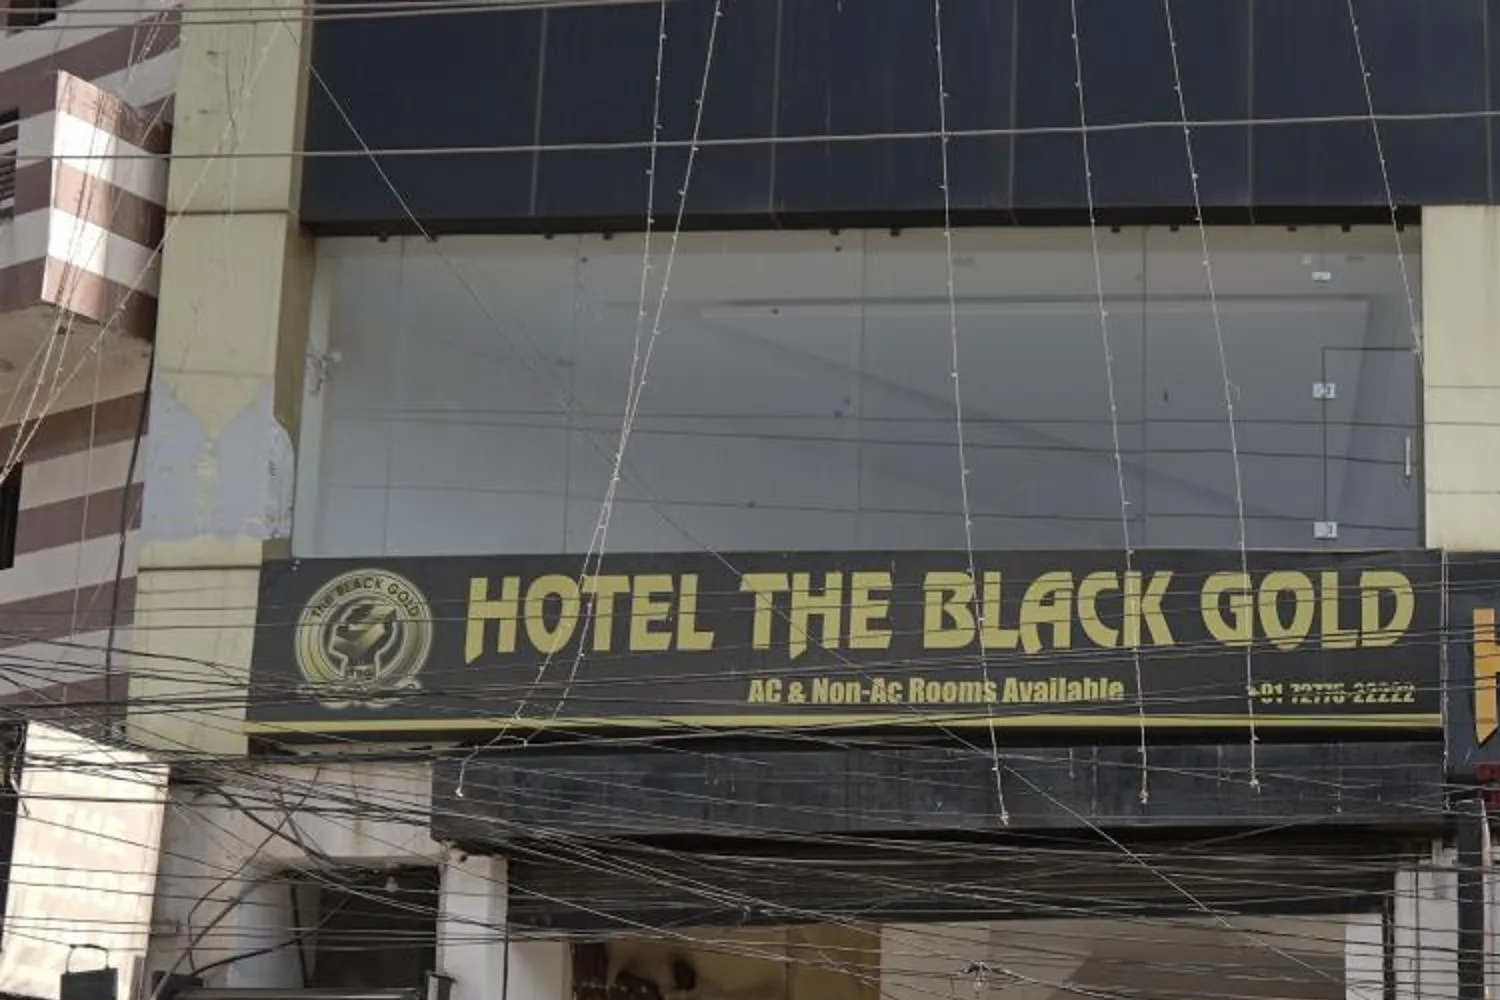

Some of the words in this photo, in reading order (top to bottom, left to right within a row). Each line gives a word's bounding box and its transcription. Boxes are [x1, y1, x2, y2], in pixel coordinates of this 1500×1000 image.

[387, 583, 421, 617] GOLD
[464, 574, 714, 664] HOTEL
[740, 572, 893, 660] THE
[923, 571, 1176, 655] BLACK
[1201, 571, 1415, 652] GOLD
[747, 678, 783, 704] AC
[788, 679, 807, 704] &
[908, 677, 998, 704] Rooms
[1001, 675, 1125, 702] Available
